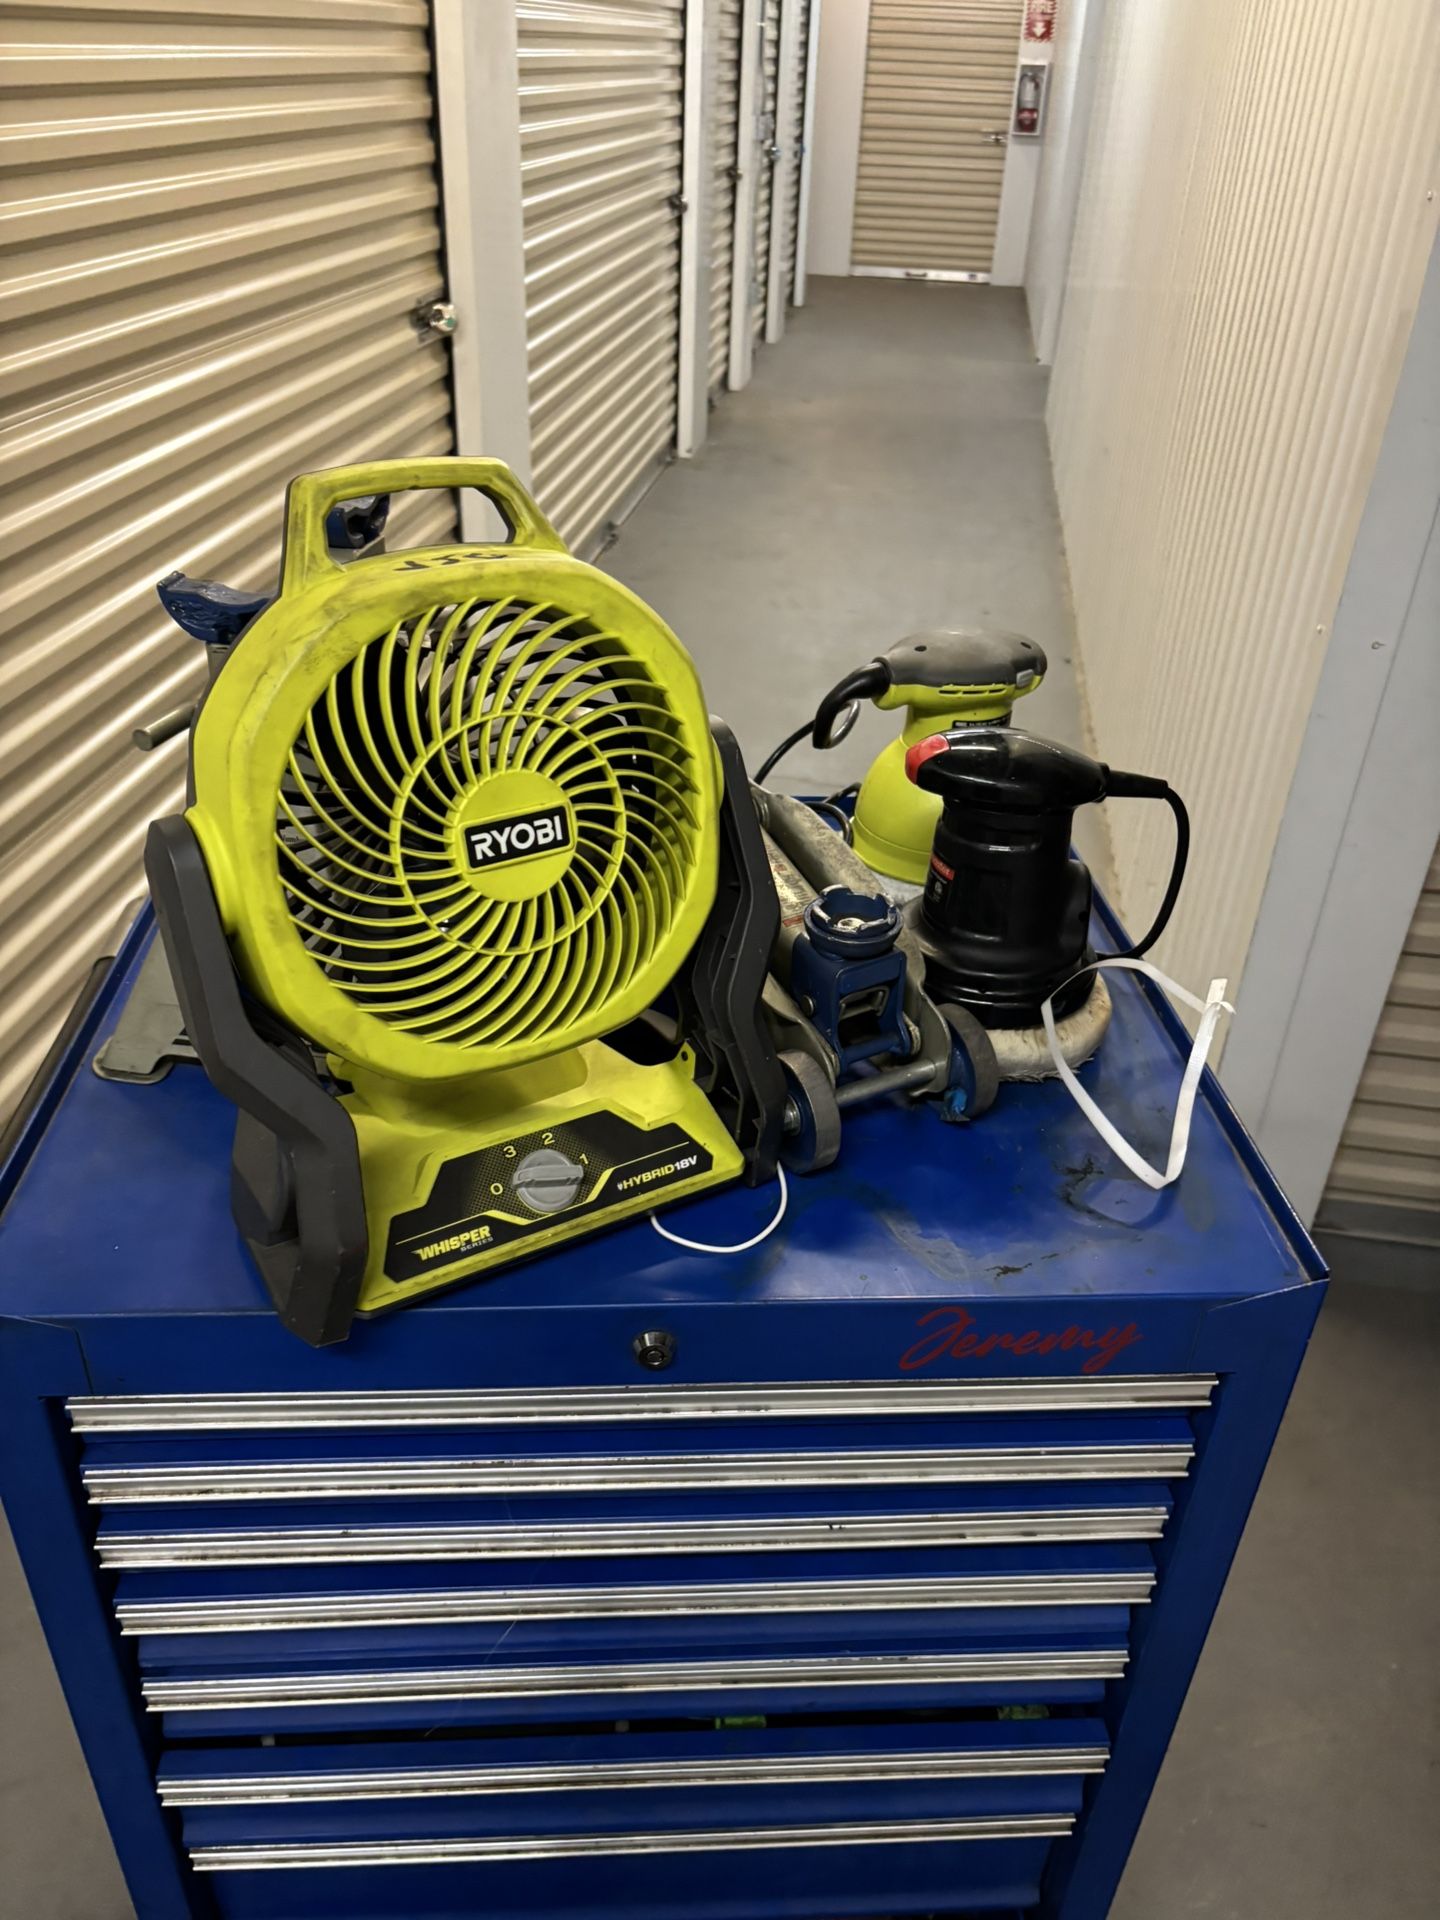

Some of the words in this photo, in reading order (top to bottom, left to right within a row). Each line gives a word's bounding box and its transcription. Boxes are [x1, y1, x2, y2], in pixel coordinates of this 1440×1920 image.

[470, 815, 563, 861] RYOBI
[541, 1132, 555, 1145] 2
[503, 1145, 517, 1158] 3
[579, 1153, 589, 1165] 1
[412, 1225, 492, 1261] WHISPER
[460, 1236, 494, 1252] SERIES
[899, 1306, 1144, 1374] Jeremy
